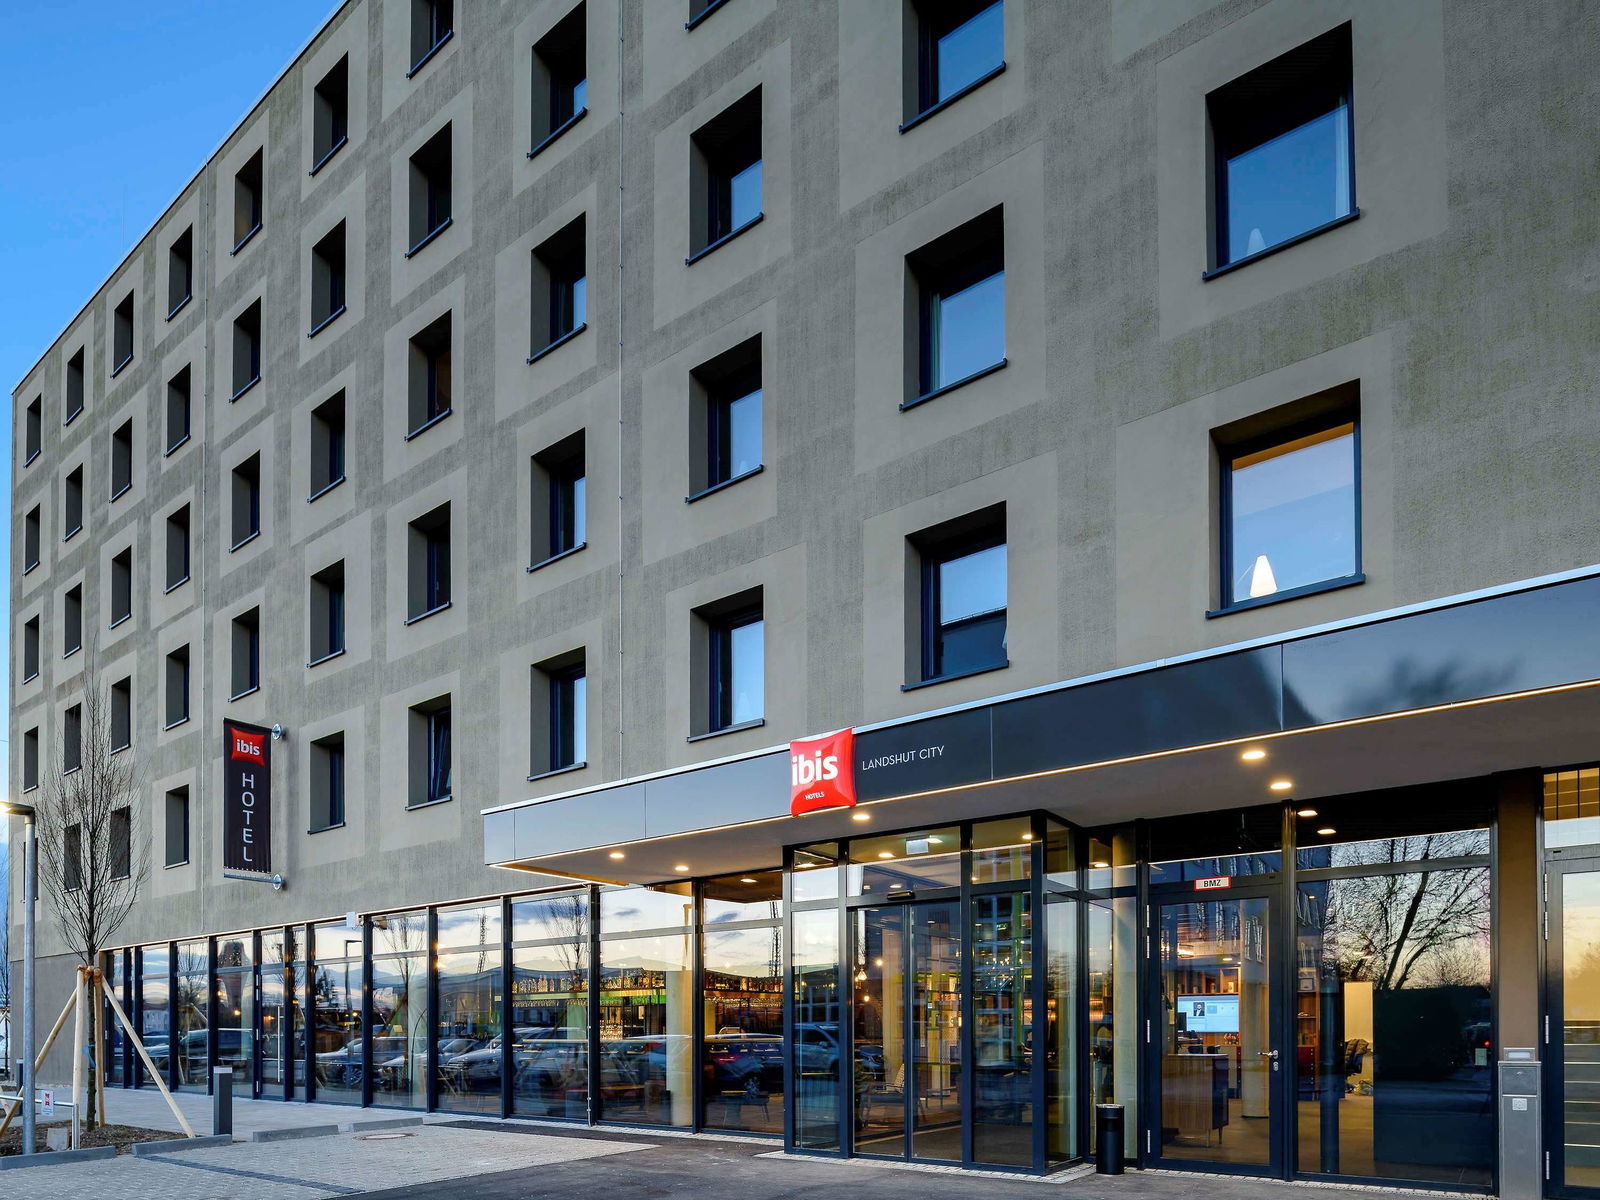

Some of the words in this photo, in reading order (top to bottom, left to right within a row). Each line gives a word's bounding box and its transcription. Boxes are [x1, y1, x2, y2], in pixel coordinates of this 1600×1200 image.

[236, 739, 260, 756] ibis
[862, 751, 916, 770] LANDSHUT
[919, 745, 945, 760] CITY
[792, 750, 838, 786] ibis
[804, 791, 825, 800] HOTELS
[241, 772, 255, 862] HOTEL
